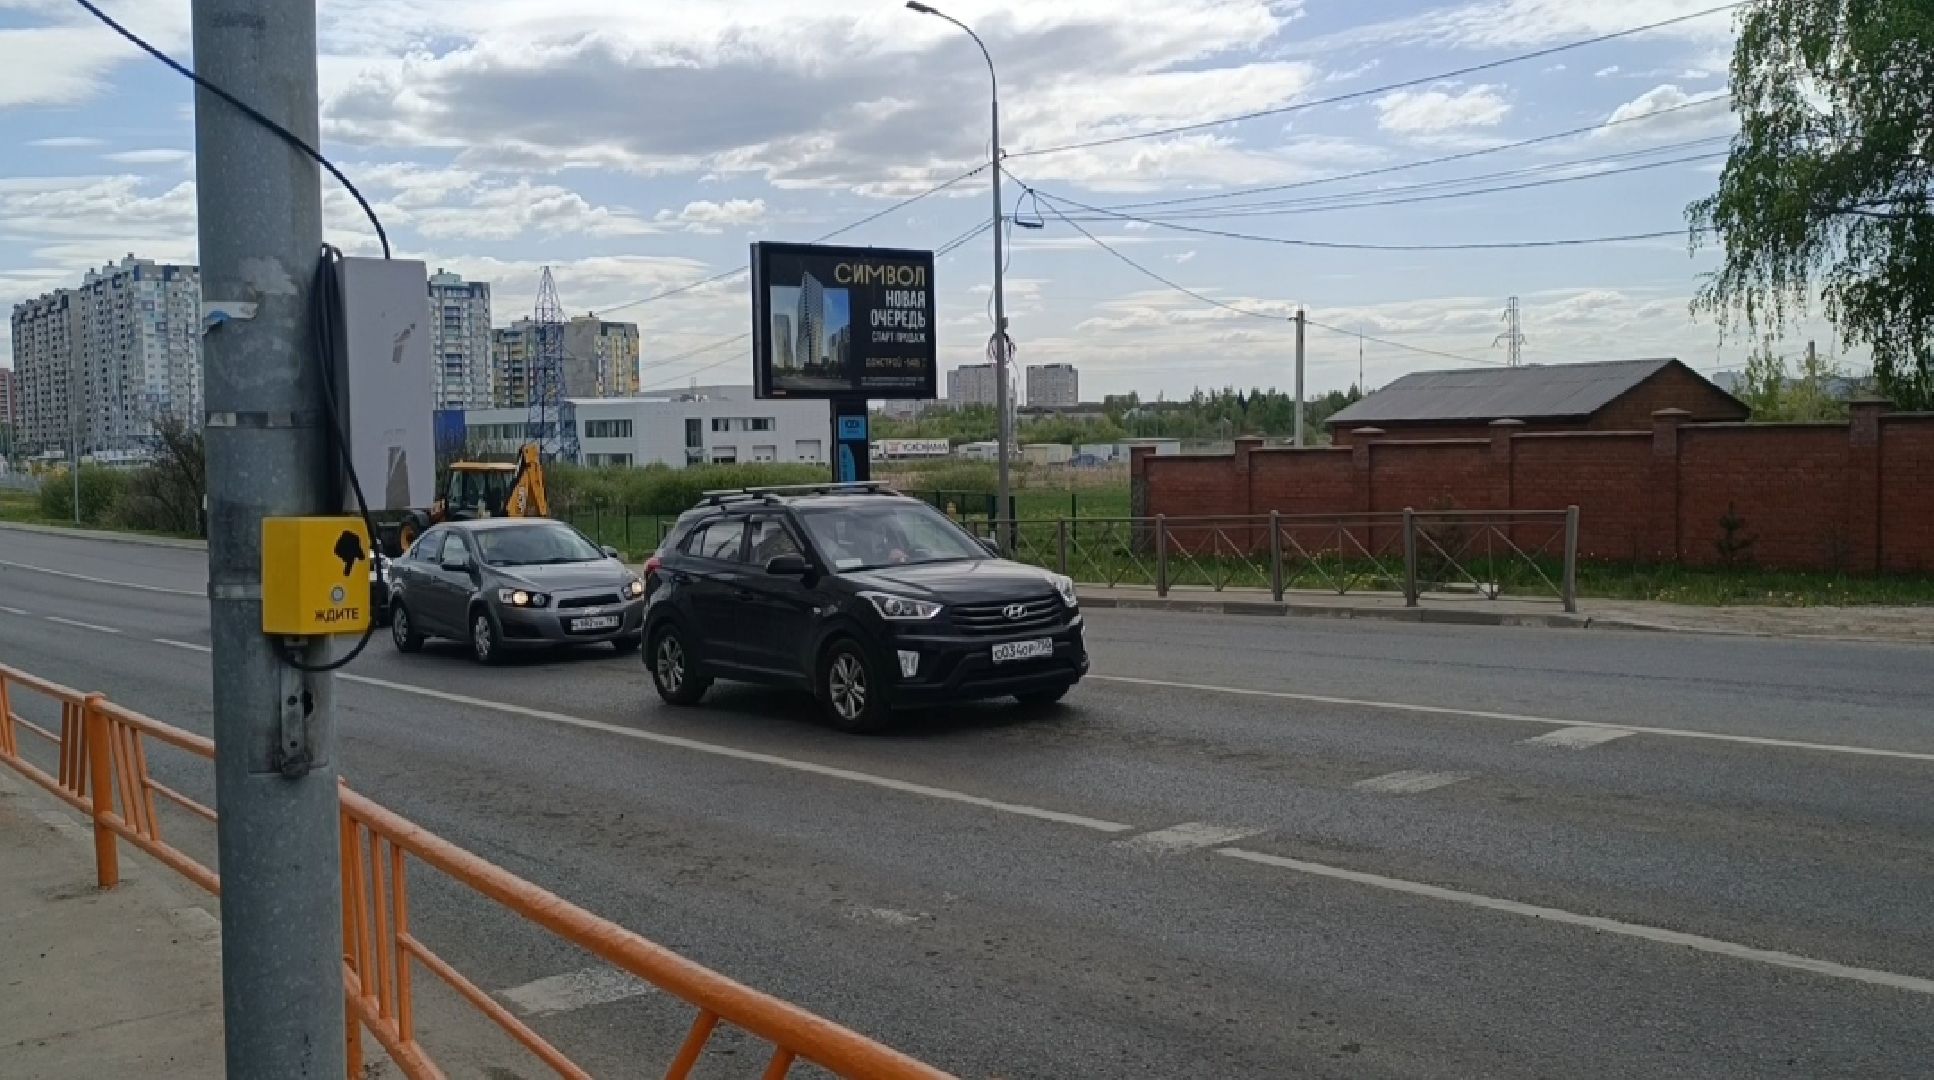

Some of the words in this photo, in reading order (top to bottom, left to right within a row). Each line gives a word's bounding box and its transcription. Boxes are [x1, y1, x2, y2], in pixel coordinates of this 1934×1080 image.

[834, 263, 925, 287] СИМВОЛ
[885, 290, 926, 308] НОВАЯ
[871, 309, 926, 329] ОЧЕРЕДЬ
[314, 607, 360, 623] ЖДИТЕ
